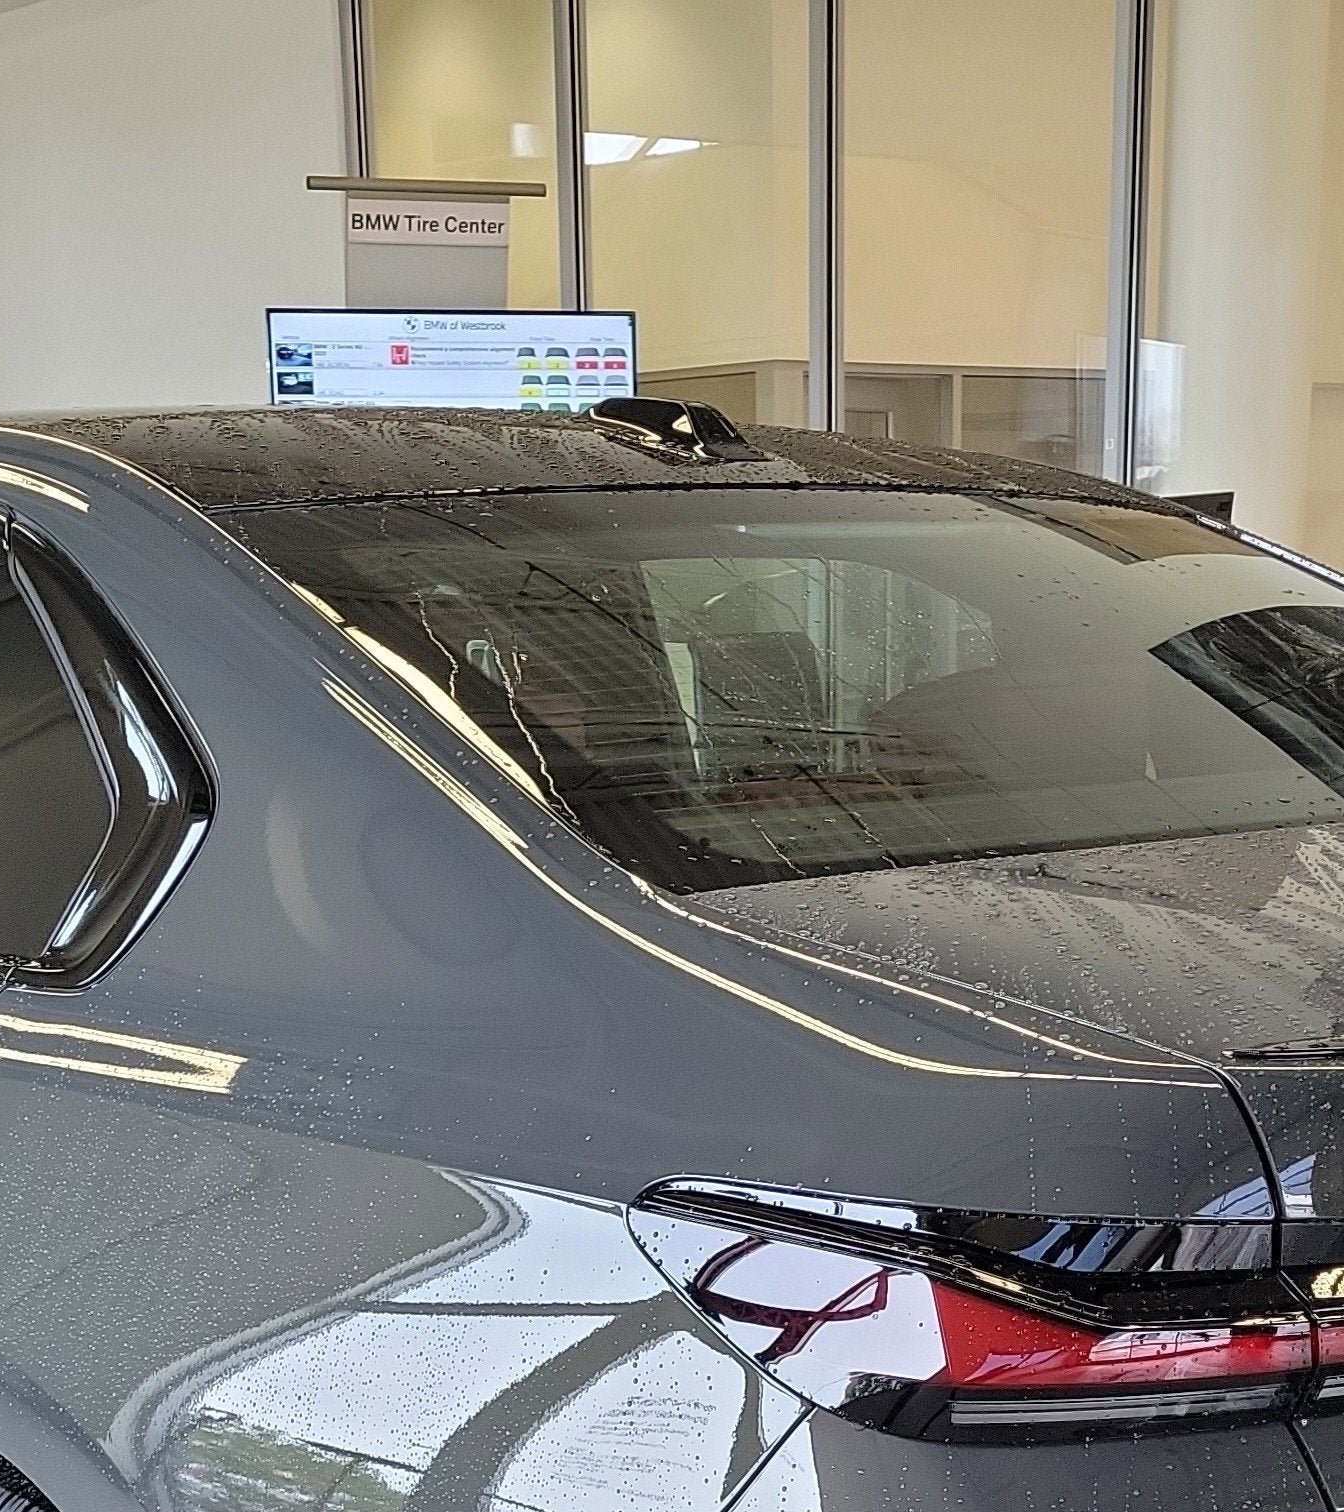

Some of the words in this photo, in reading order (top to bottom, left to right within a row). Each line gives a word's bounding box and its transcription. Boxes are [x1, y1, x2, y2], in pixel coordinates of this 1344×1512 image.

[351, 213, 399, 231] BMW
[404, 215, 440, 232] Tire
[444, 216, 505, 235] Center
[424, 320, 448, 330] BMW
[451, 319, 458, 330] of
